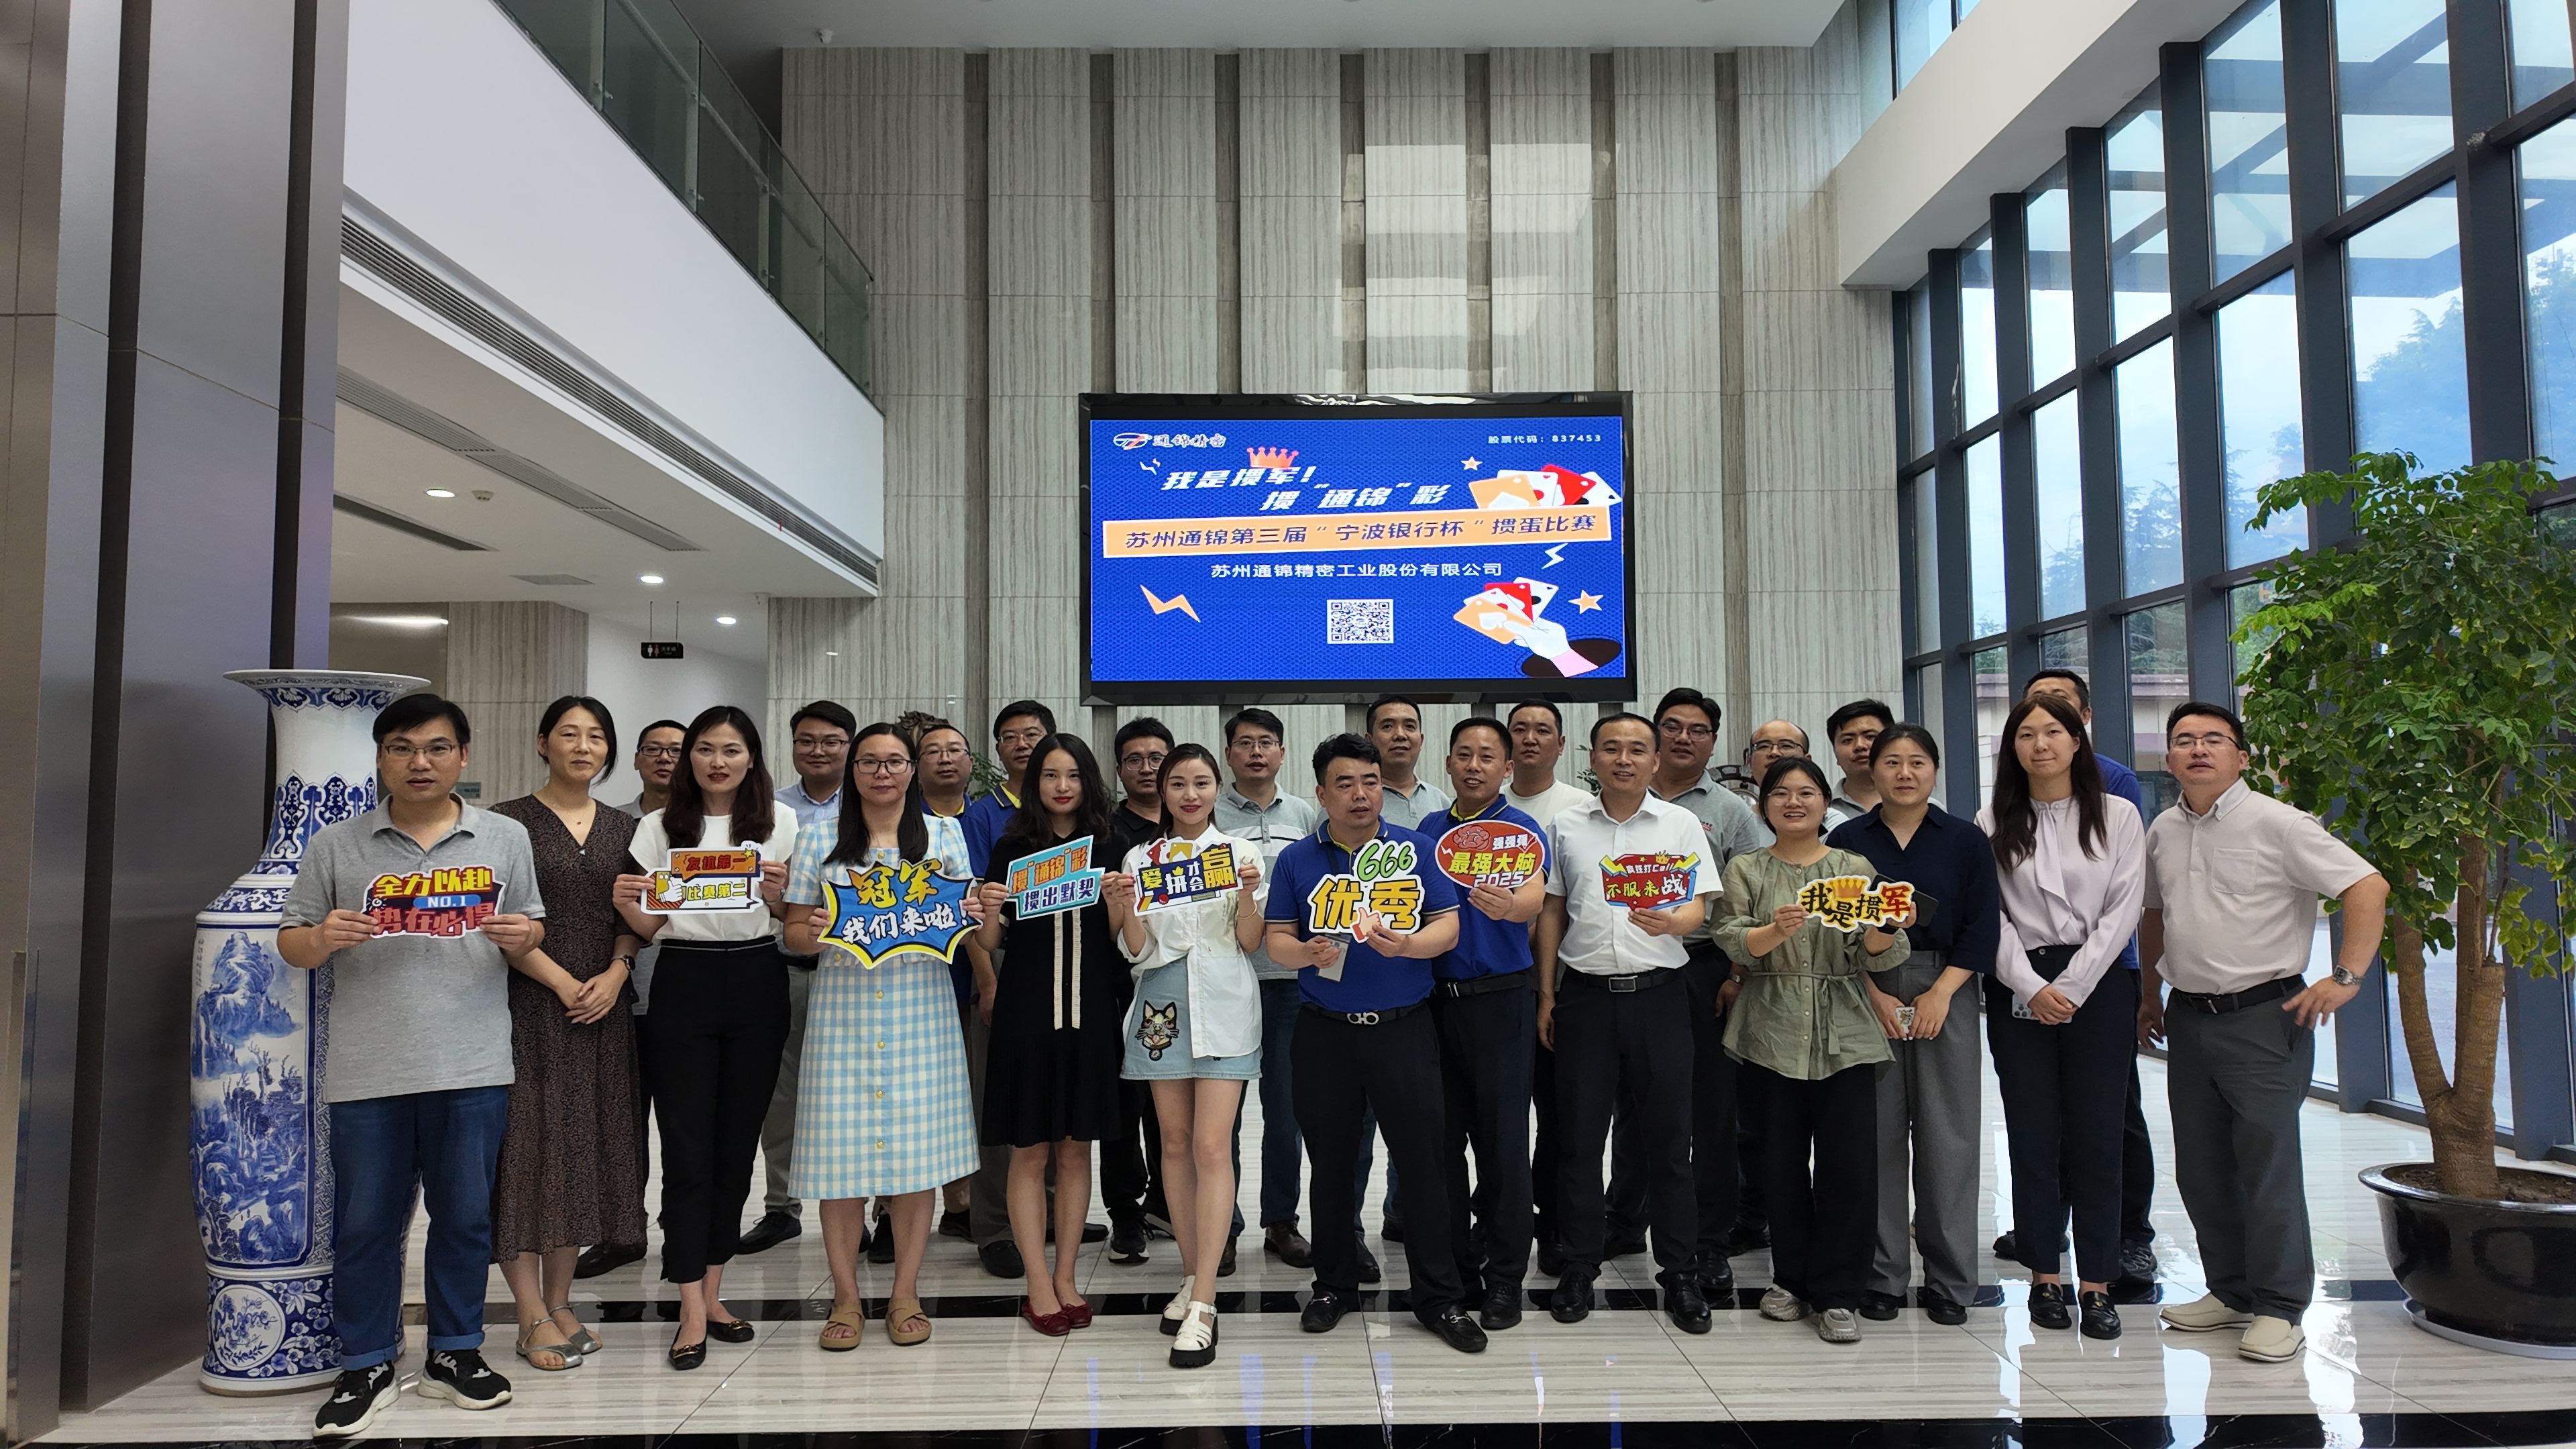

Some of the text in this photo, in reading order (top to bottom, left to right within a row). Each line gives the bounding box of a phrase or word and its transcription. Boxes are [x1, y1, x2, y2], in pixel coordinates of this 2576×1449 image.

[1211, 563, 1502, 578] 苏州通锦精密工业股份有限公司
[686, 855, 747, 871] 友谊第一
[1142, 848, 1236, 895] 爱拼才会赢
[1357, 843, 1412, 881] 666
[1449, 852, 1536, 875] 最强大脑
[375, 868, 490, 897] 全力以赴
[687, 883, 747, 901] 比赛第二
[847, 859, 942, 908] 冠军
[1474, 871, 1524, 888] 2025
[1607, 873, 1687, 898] 不服来战
[427, 896, 466, 908] NO.1
[1024, 877, 1093, 912] 掼出默契
[1311, 879, 1421, 930] 优秀
[1801, 882, 1911, 928] 我是掼军
[370, 903, 494, 936] 势在必得
